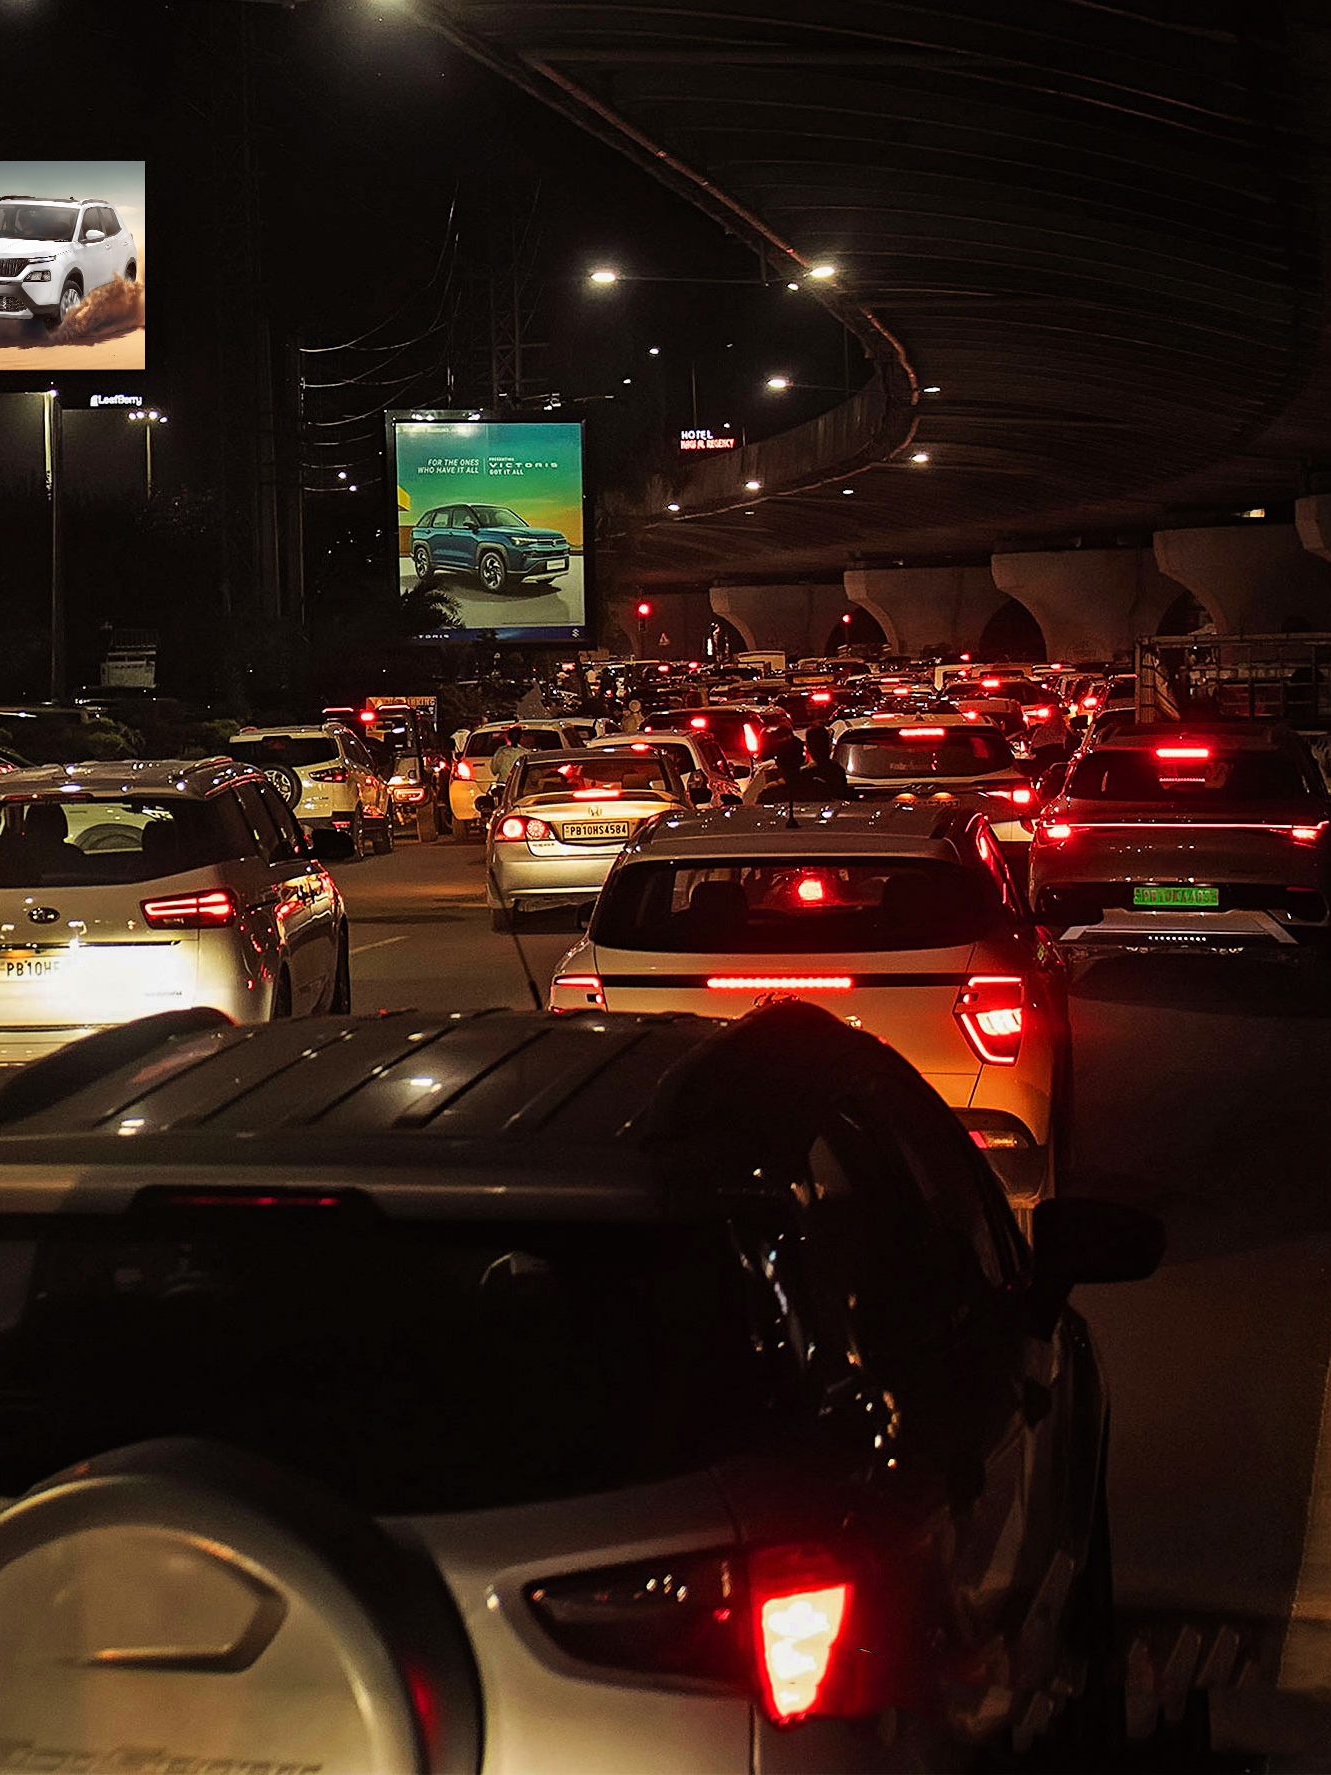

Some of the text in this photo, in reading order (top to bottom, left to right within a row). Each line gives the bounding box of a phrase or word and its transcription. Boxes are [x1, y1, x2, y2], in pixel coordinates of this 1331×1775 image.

[681, 430, 714, 440] HOTEL
[417, 466, 435, 474] WHO
[436, 466, 456, 474] HAVE
[570, 825, 626, 836] PB10HS4584
